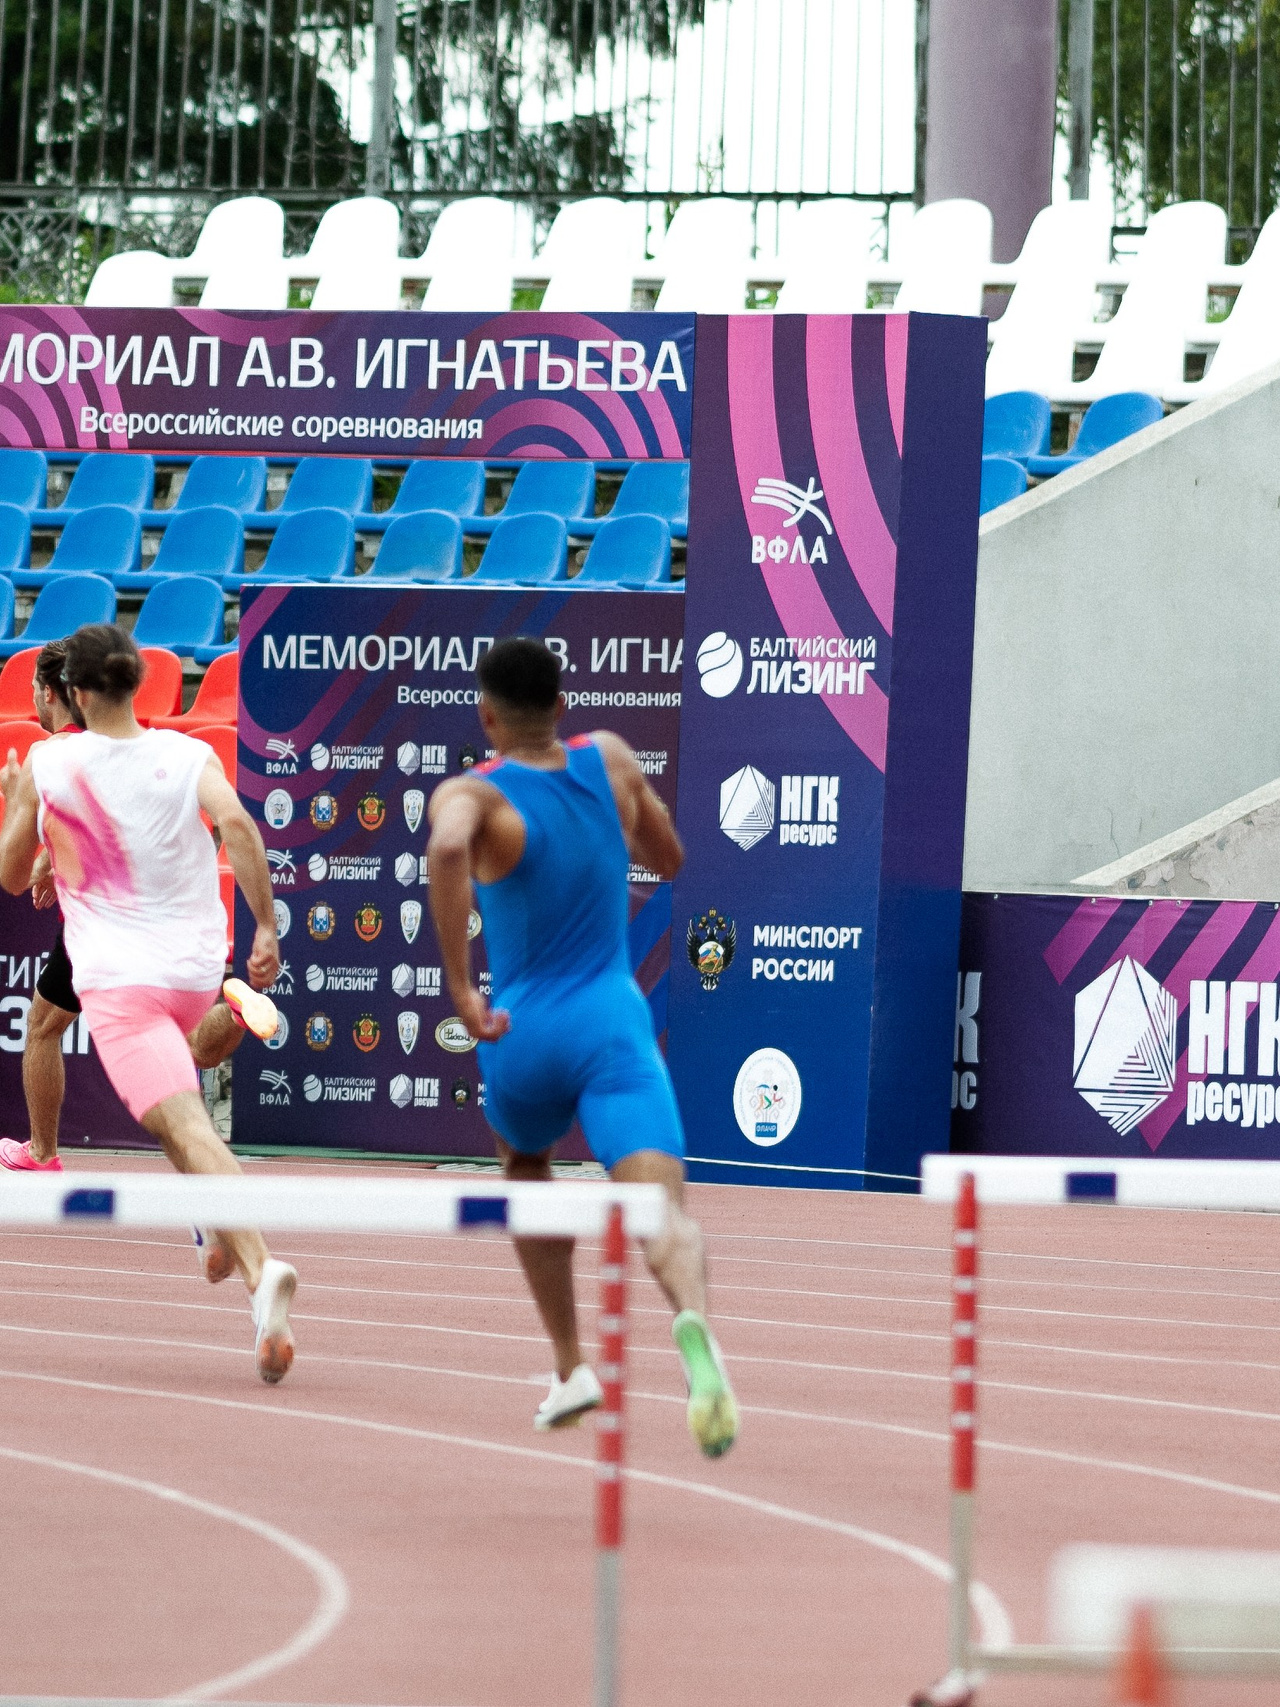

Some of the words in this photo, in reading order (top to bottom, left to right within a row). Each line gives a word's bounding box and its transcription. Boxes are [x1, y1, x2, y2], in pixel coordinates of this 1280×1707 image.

[236, 336, 336, 389] А.В.
[355, 338, 687, 392] ИГНАТЬЕВА
[80, 406, 284, 440] Всероссийские
[291, 415, 483, 442] соревнования
[751, 535, 828, 564] ВФЛА
[263, 634, 494, 672] МЕМОРИАЛ
[750, 636, 876, 658] БАЛТИЙСКИЙ
[746, 661, 876, 695] ЛИЗИНГ
[331, 745, 384, 755] БАЛТИЙСКИЙ
[422, 745, 447, 764] НГК
[266, 762, 297, 774] ВФЛА
[330, 755, 384, 770] ЛИЗИНГ
[780, 775, 840, 822] НГК
[779, 823, 838, 847] ресурс
[329, 856, 381, 865] БАЛТИЙСКИЙ
[271, 872, 295, 884] ФЛА
[328, 865, 381, 880] ЛИЗИНГ
[753, 925, 862, 949] МИНСПОРТ
[326, 966, 378, 976] БАЛТИЙСКИЙ
[416, 967, 441, 986] НГК
[751, 958, 834, 982] РОССИИ
[325, 976, 378, 991] ЛИЗИНГ
[324, 1077, 376, 1086] БАЛТИЙСКИЙ
[414, 1077, 440, 1097] НГК
[259, 1092, 290, 1105] ВФЛА
[323, 1087, 376, 1102] ЛИЗИНГ
